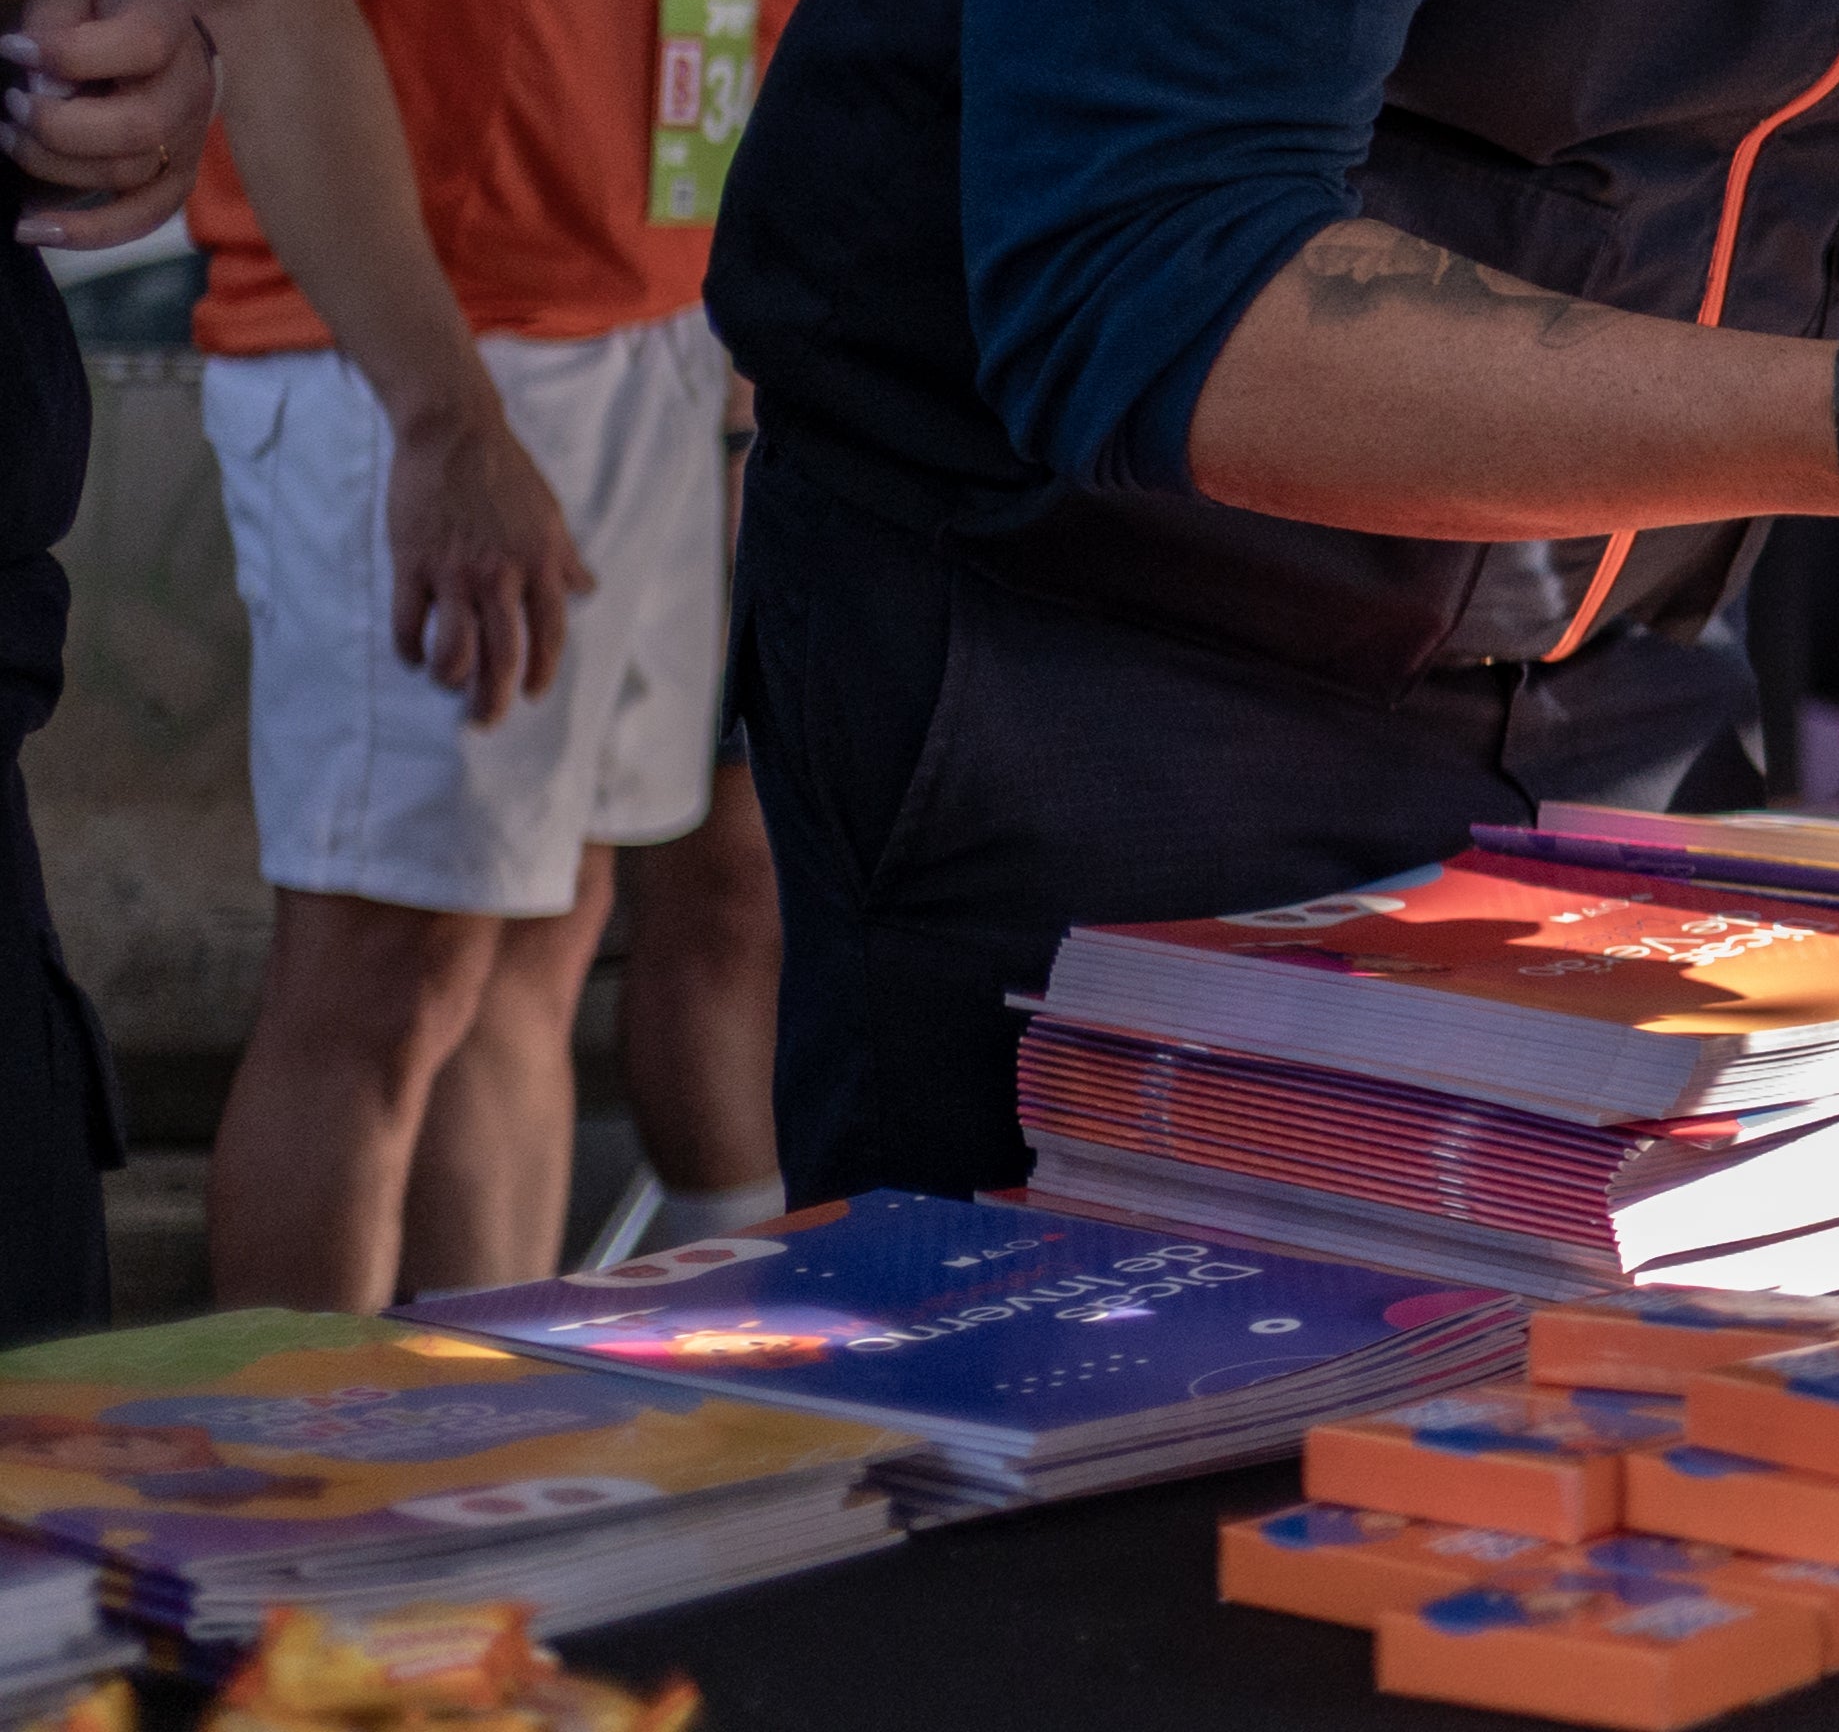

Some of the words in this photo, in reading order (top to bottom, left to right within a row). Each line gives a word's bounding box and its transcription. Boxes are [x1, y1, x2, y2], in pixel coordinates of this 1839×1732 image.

[1113, 1244, 1210, 1273] de
[846, 1274, 1128, 1352] Inverno
[1055, 1261, 1264, 1323] Dicas
